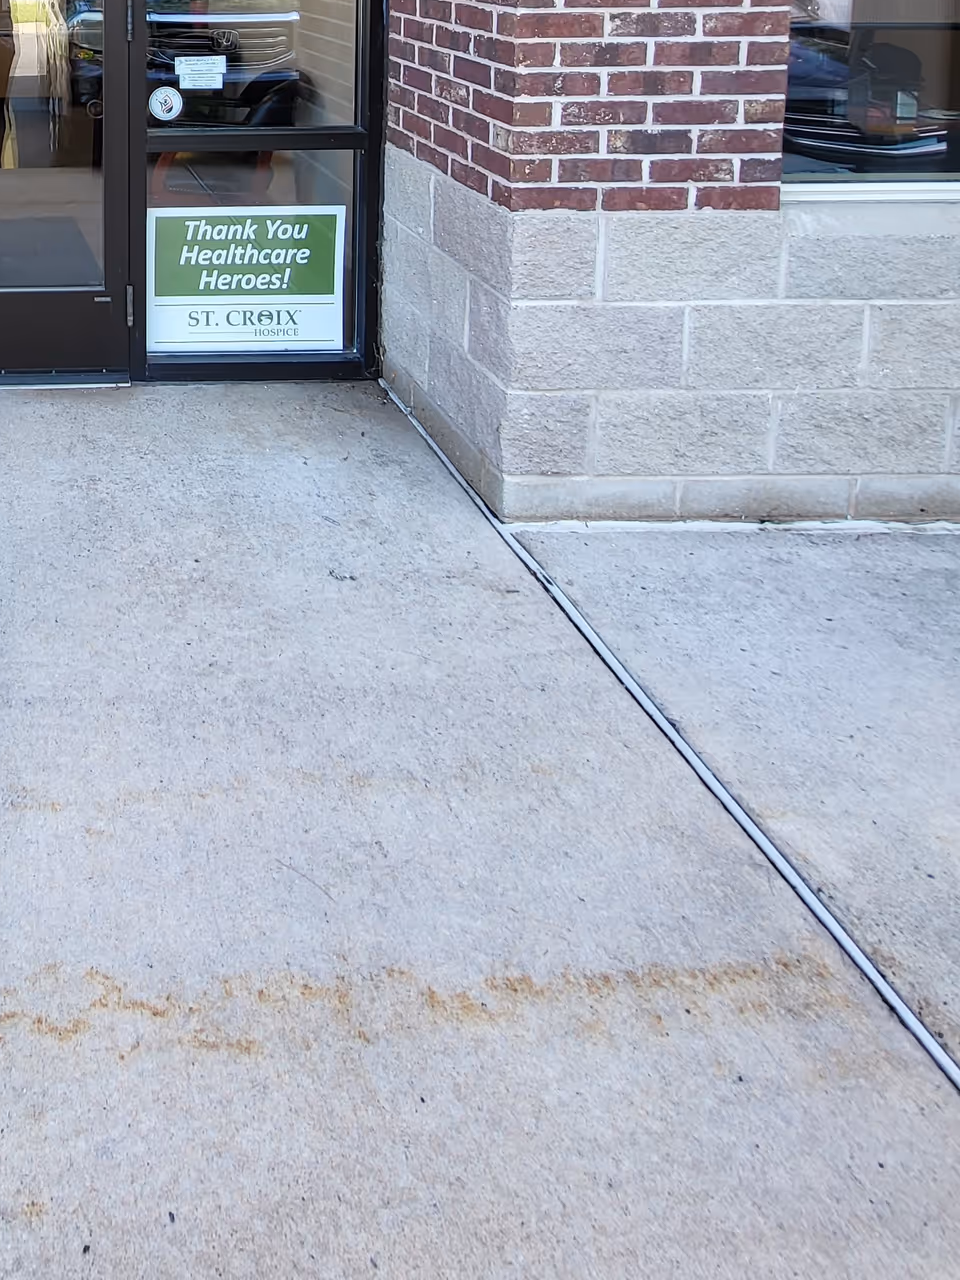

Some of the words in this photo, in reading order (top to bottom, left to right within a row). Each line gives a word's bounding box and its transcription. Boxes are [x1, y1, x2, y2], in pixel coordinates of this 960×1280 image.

[184, 219, 258, 241] Thank
[265, 219, 309, 240] You
[179, 243, 311, 266] Healthcare
[198, 267, 291, 290] Heroes!
[188, 310, 219, 327] ST.
[225, 309, 302, 326] CROIX
[253, 328, 299, 337] HOSPICE
